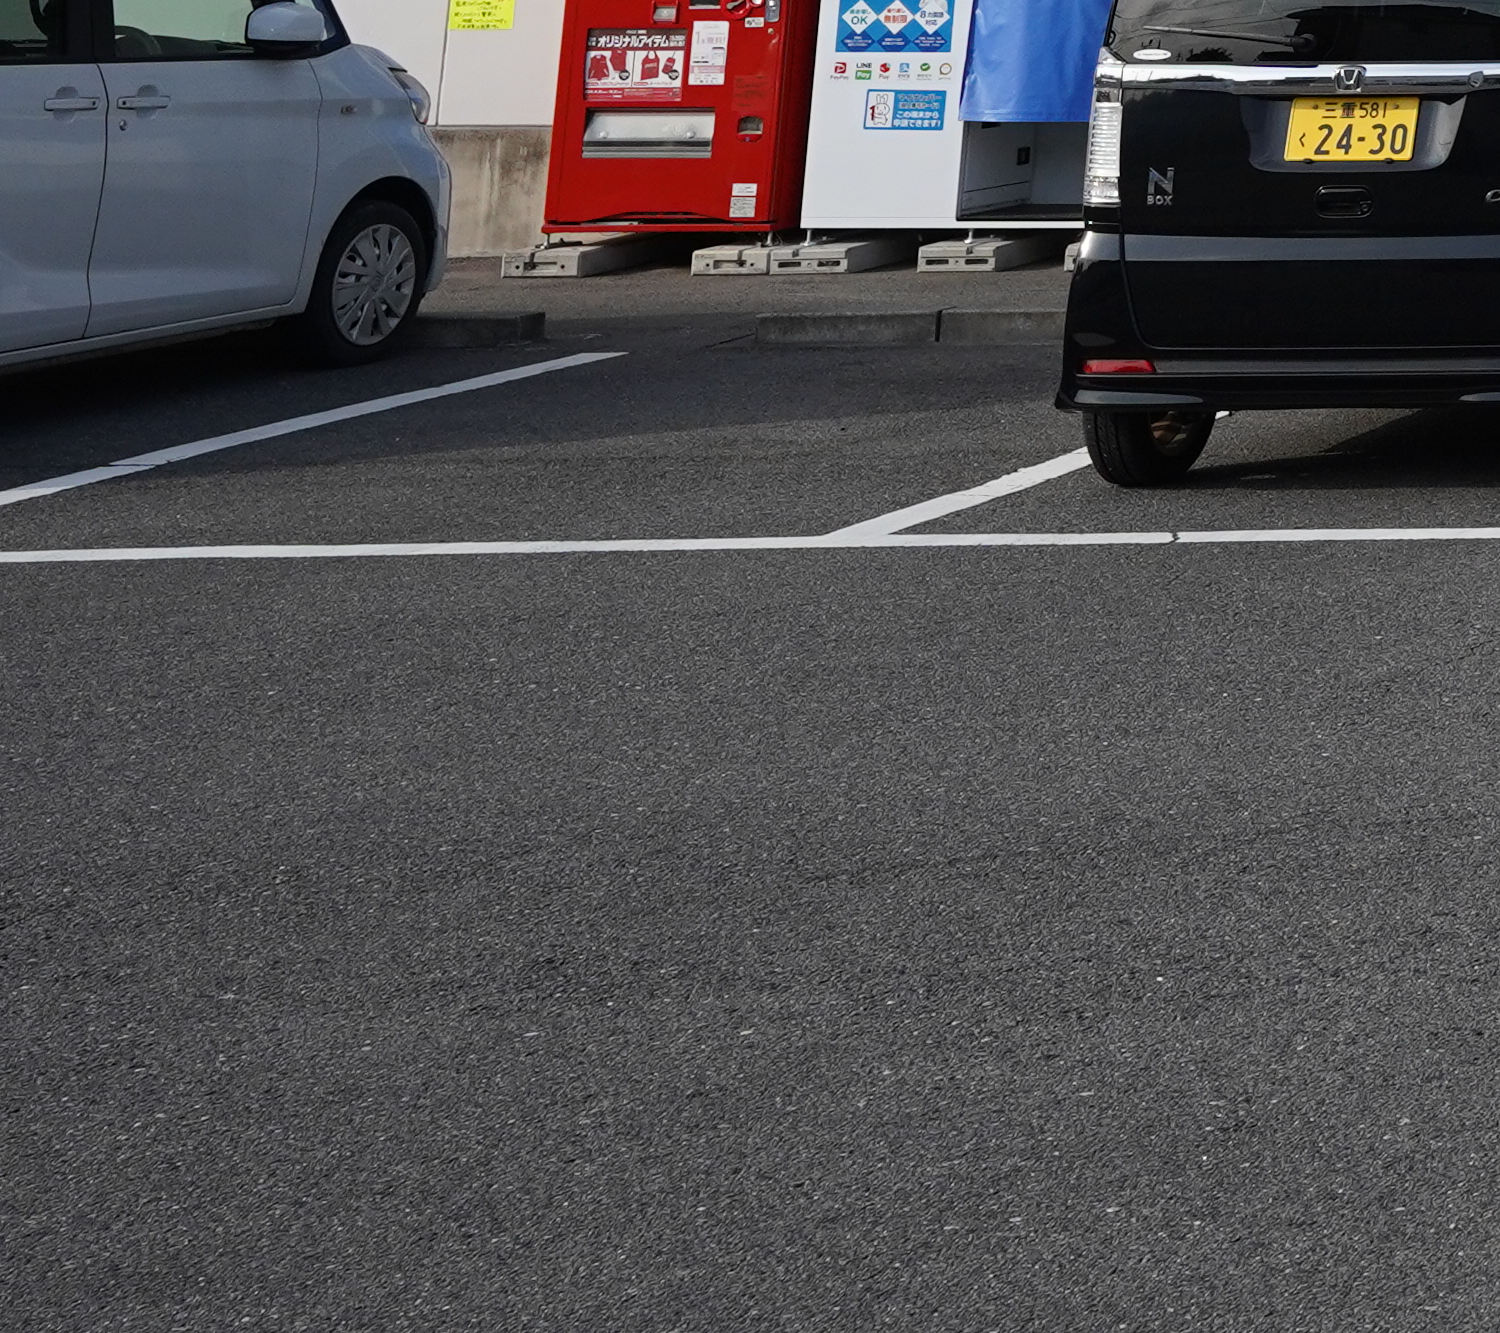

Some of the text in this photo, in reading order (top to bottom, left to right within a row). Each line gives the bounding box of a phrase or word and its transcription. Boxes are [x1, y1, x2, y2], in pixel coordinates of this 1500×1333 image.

[851, 16, 868, 25] OK
[597, 35, 669, 48] オリジナルアイテム
[857, 71, 870, 79] Pay
[1314, 123, 1408, 156] 24-30
[1147, 166, 1174, 195] N
[1147, 195, 1172, 205] BOX
